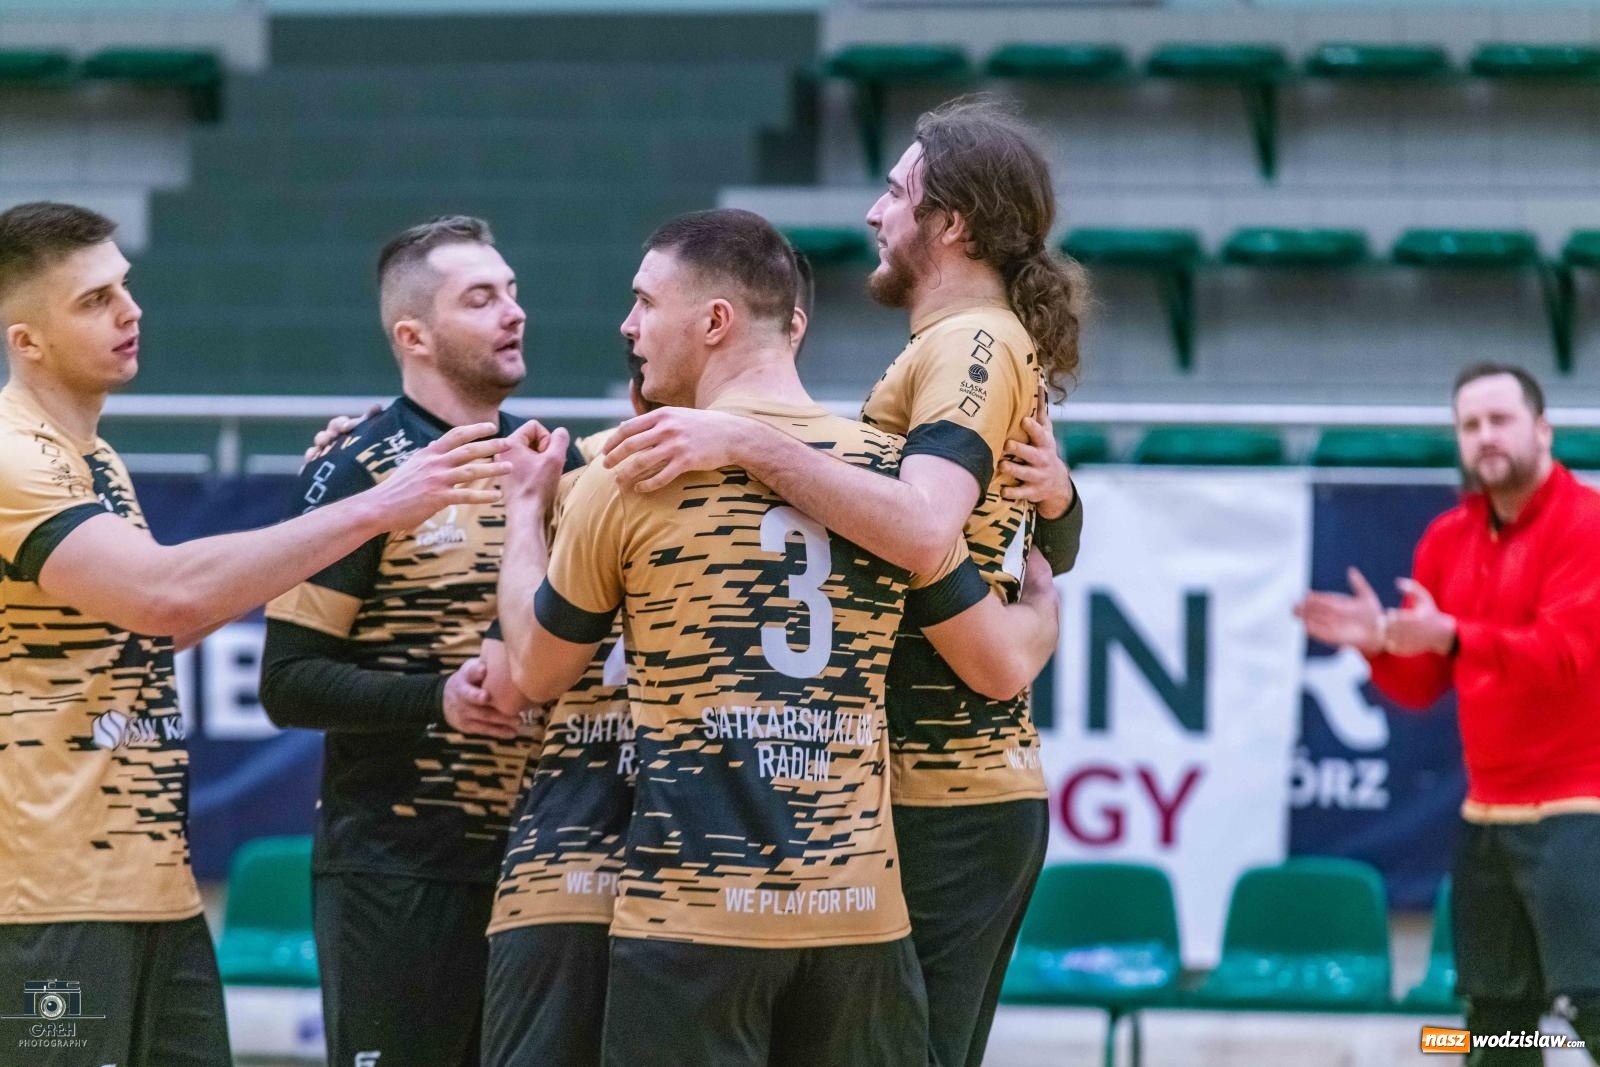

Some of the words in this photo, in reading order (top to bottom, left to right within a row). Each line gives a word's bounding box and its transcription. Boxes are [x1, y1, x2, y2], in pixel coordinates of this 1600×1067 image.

[759, 505, 834, 679] 3
[758, 745, 831, 783] RADLIN
[566, 871, 593, 894] WE
[725, 887, 756, 913] WE
[759, 889, 805, 915] PLAY
[808, 890, 841, 915] FOR
[845, 886, 876, 912] FUN
